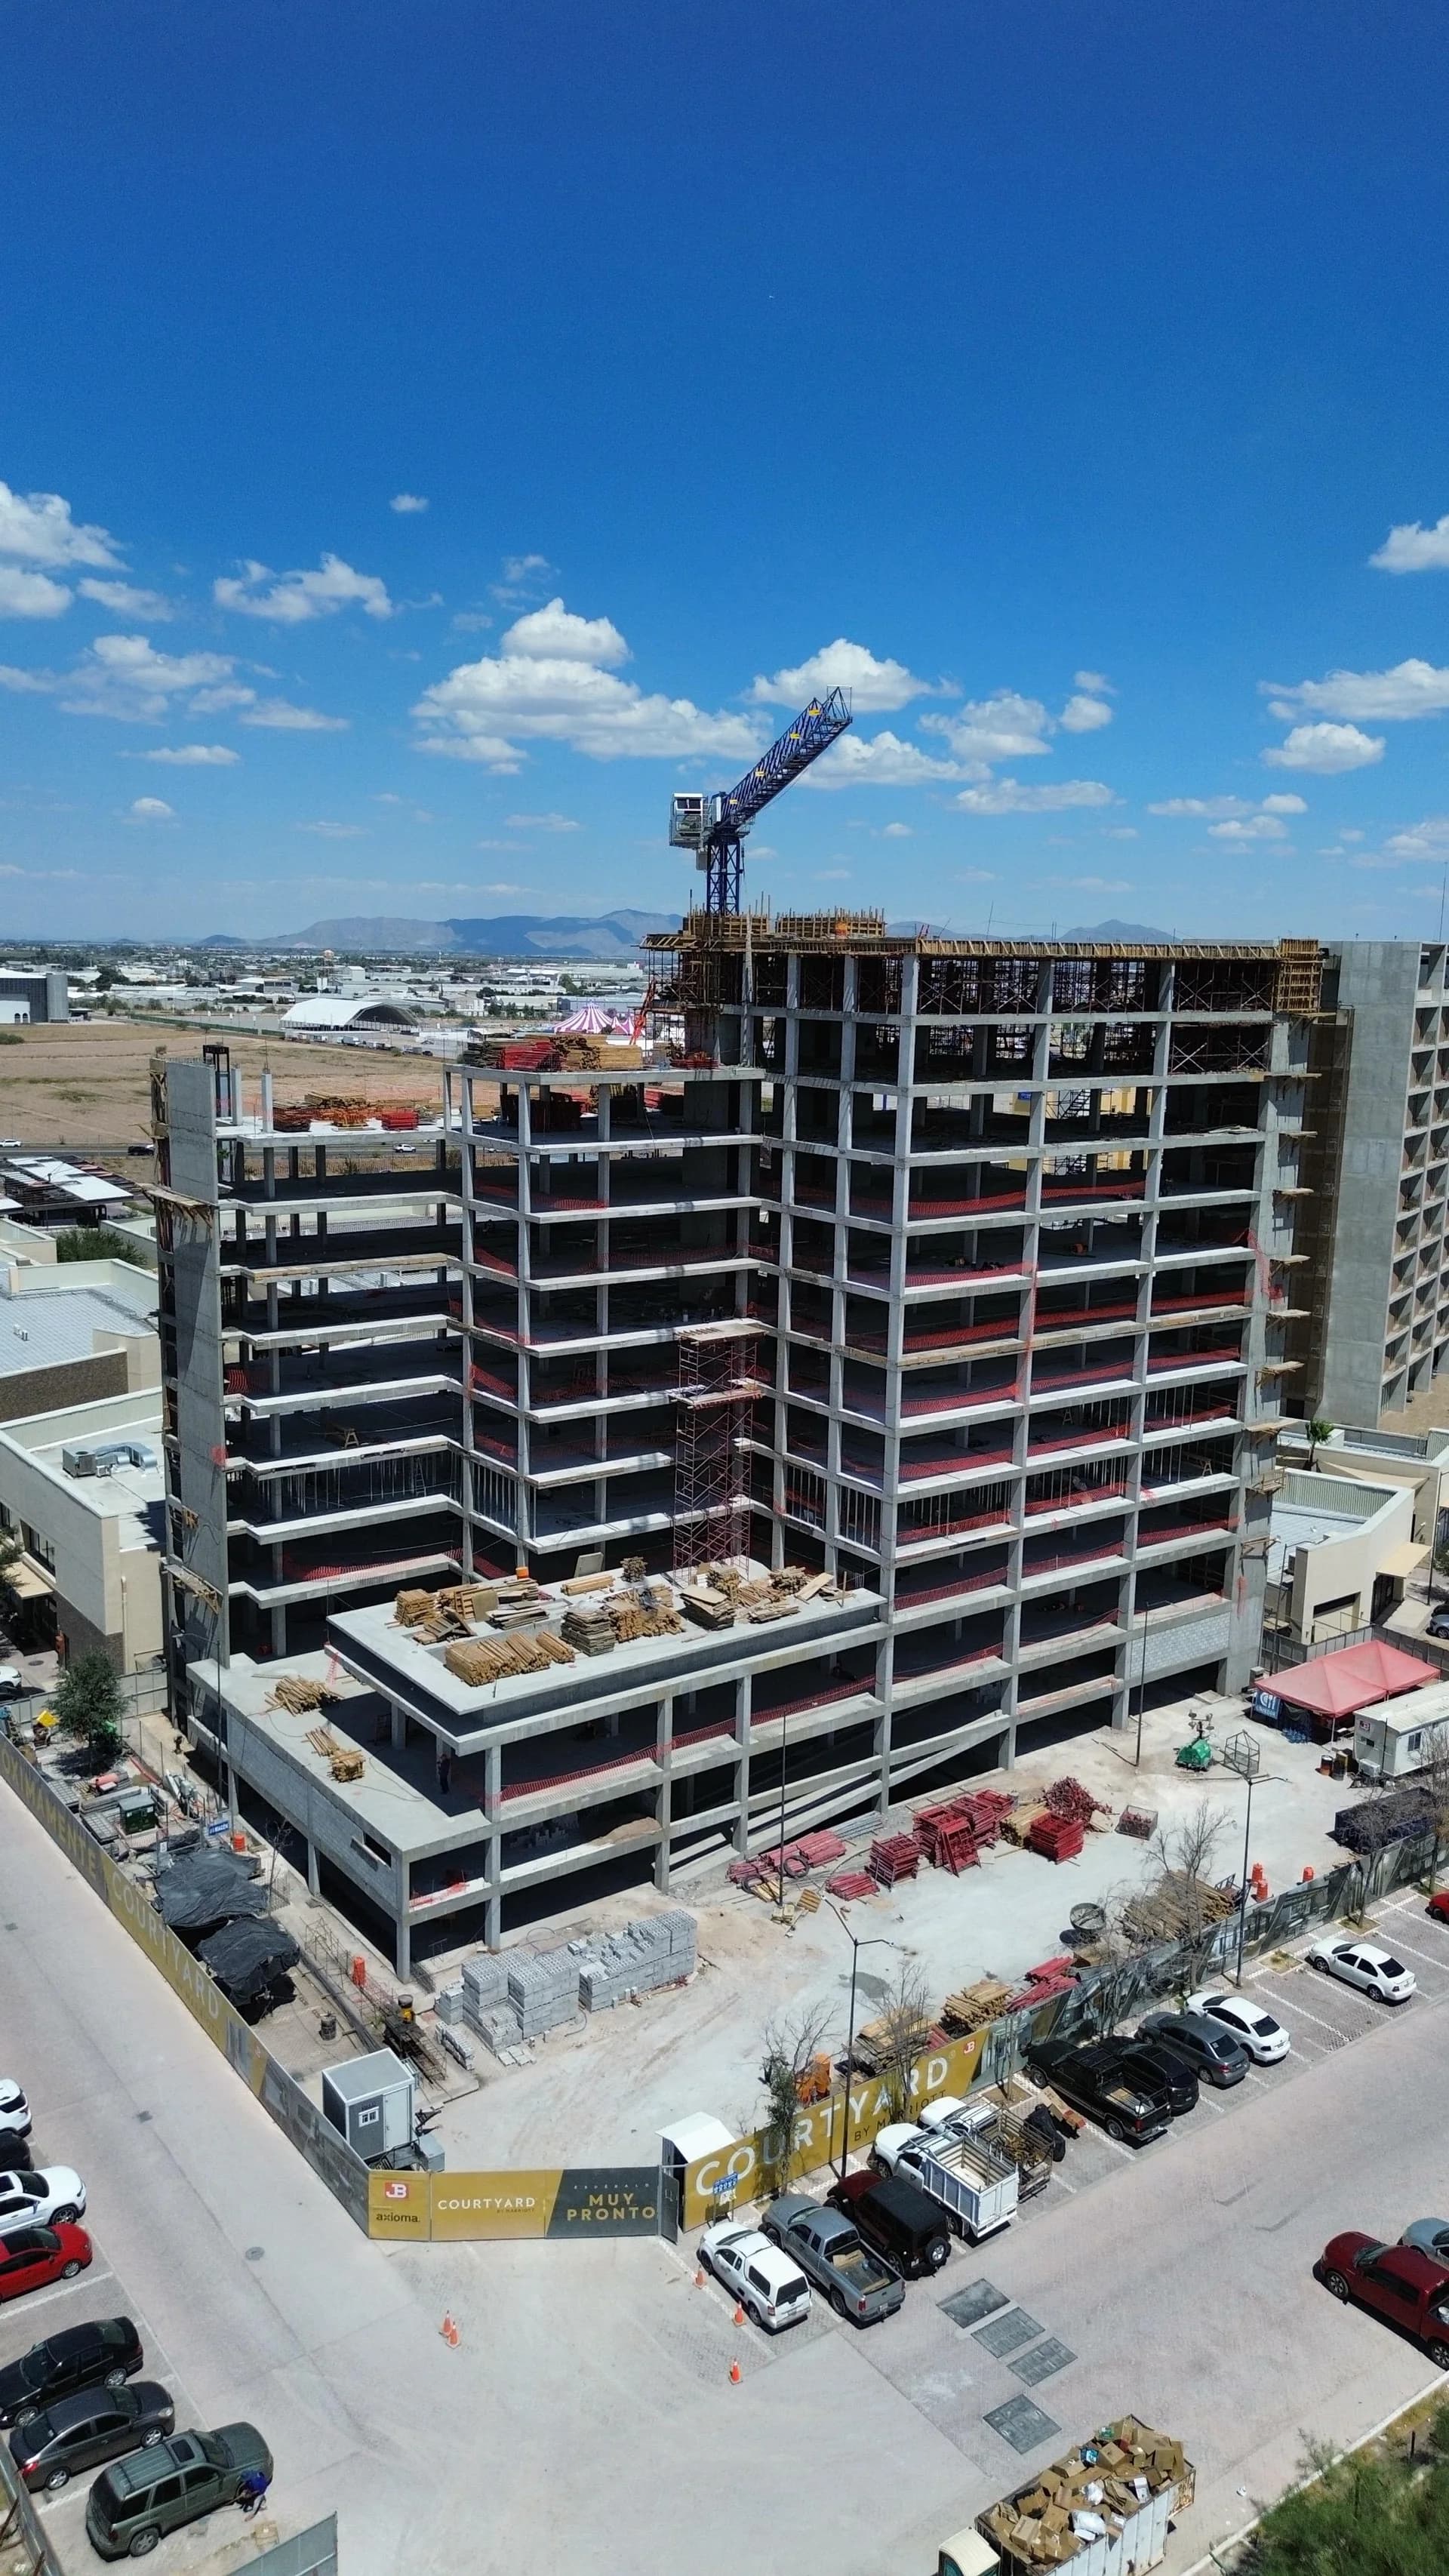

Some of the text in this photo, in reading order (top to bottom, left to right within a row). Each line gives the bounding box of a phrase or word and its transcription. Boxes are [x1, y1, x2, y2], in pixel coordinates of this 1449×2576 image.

[112, 1871, 219, 2019] COURTYARD
[696, 2057, 948, 2196] COURTYARD
[854, 2125, 870, 2141] BY
[438, 2197, 536, 2210] COURTYARD
[589, 2193, 634, 2206] MUY
[567, 2206, 656, 2221] PRONTO
